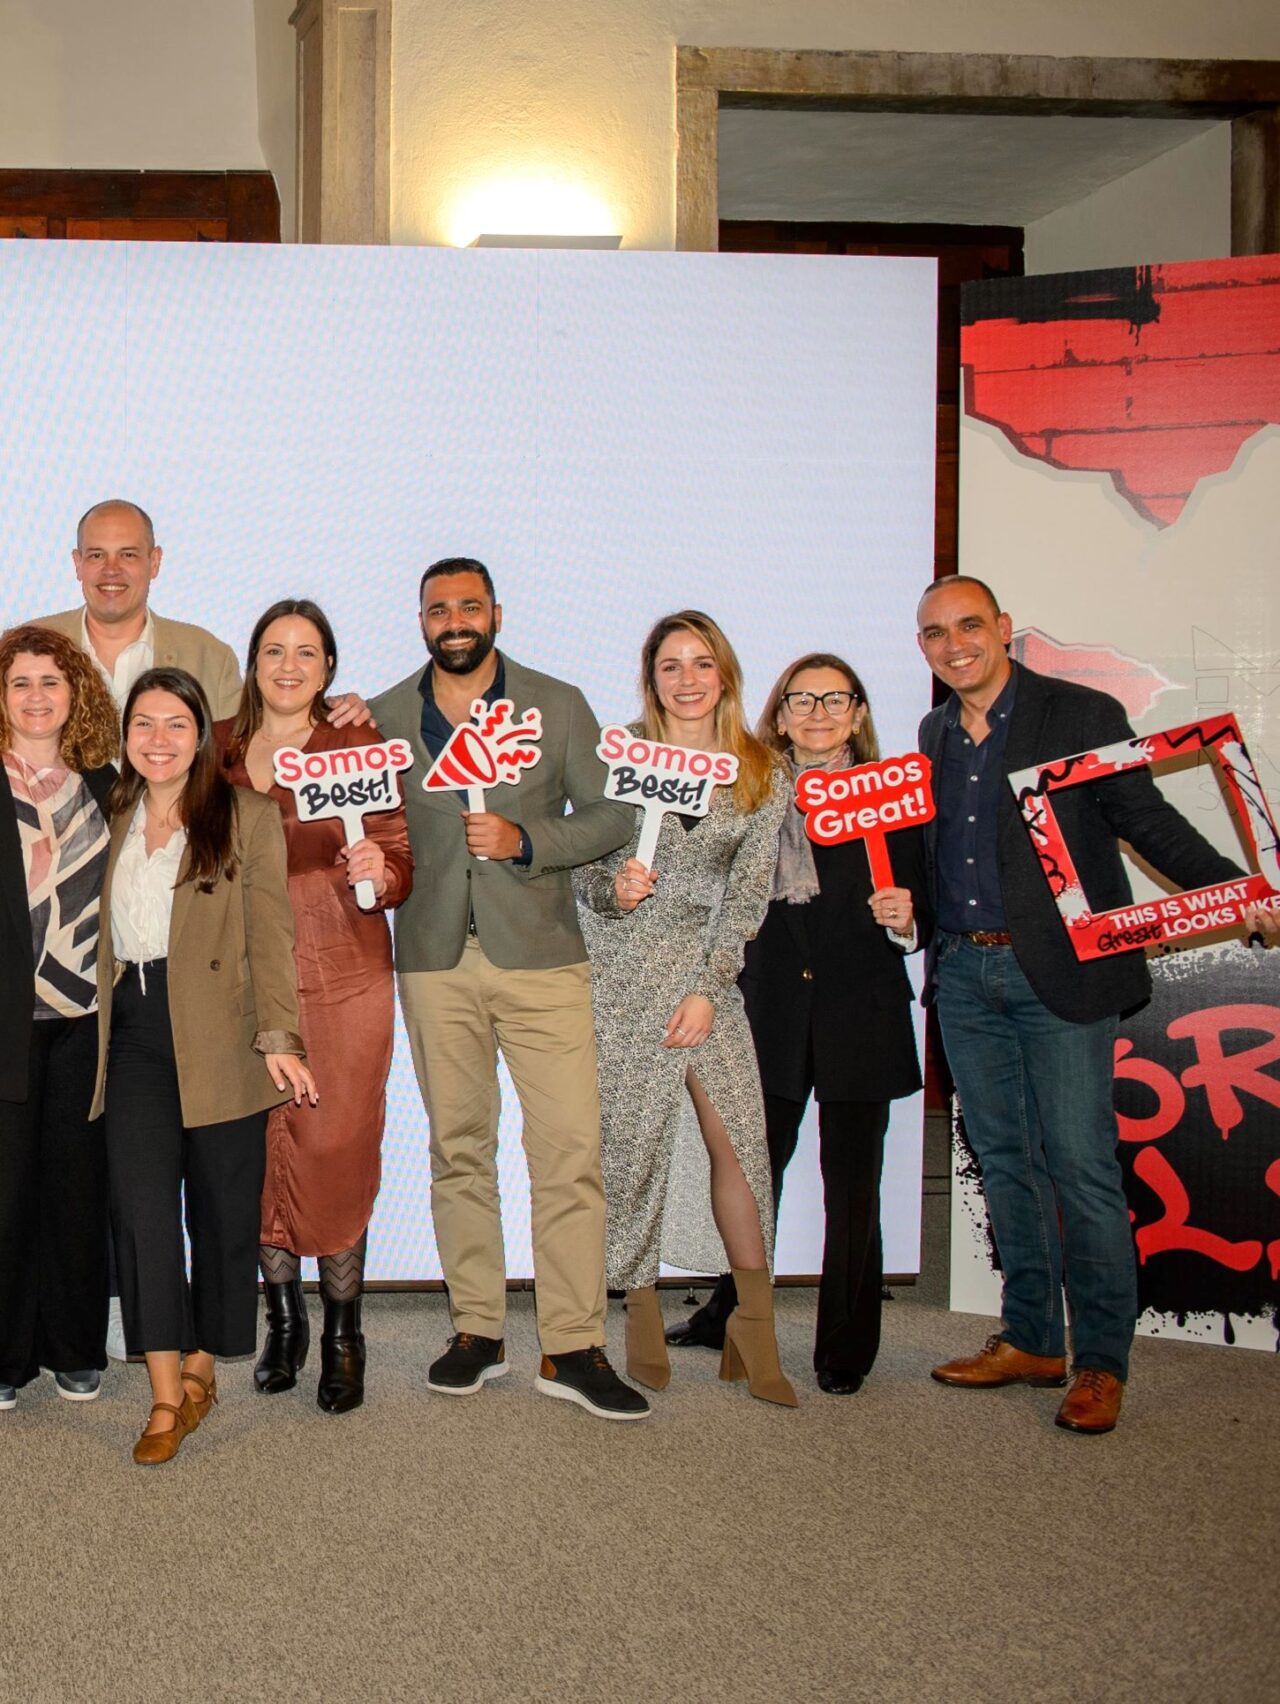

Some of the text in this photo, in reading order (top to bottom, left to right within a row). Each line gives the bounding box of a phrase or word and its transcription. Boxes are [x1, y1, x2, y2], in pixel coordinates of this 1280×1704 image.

[278, 743, 408, 782] Somos
[600, 728, 732, 781] Somos
[299, 769, 392, 815] Best!
[612, 766, 707, 811] Best!
[804, 760, 923, 806] Somos
[813, 787, 928, 838] Great!
[1108, 883, 1248, 930] THIS IS WHAT
[1162, 907, 1237, 938] LOOKS
